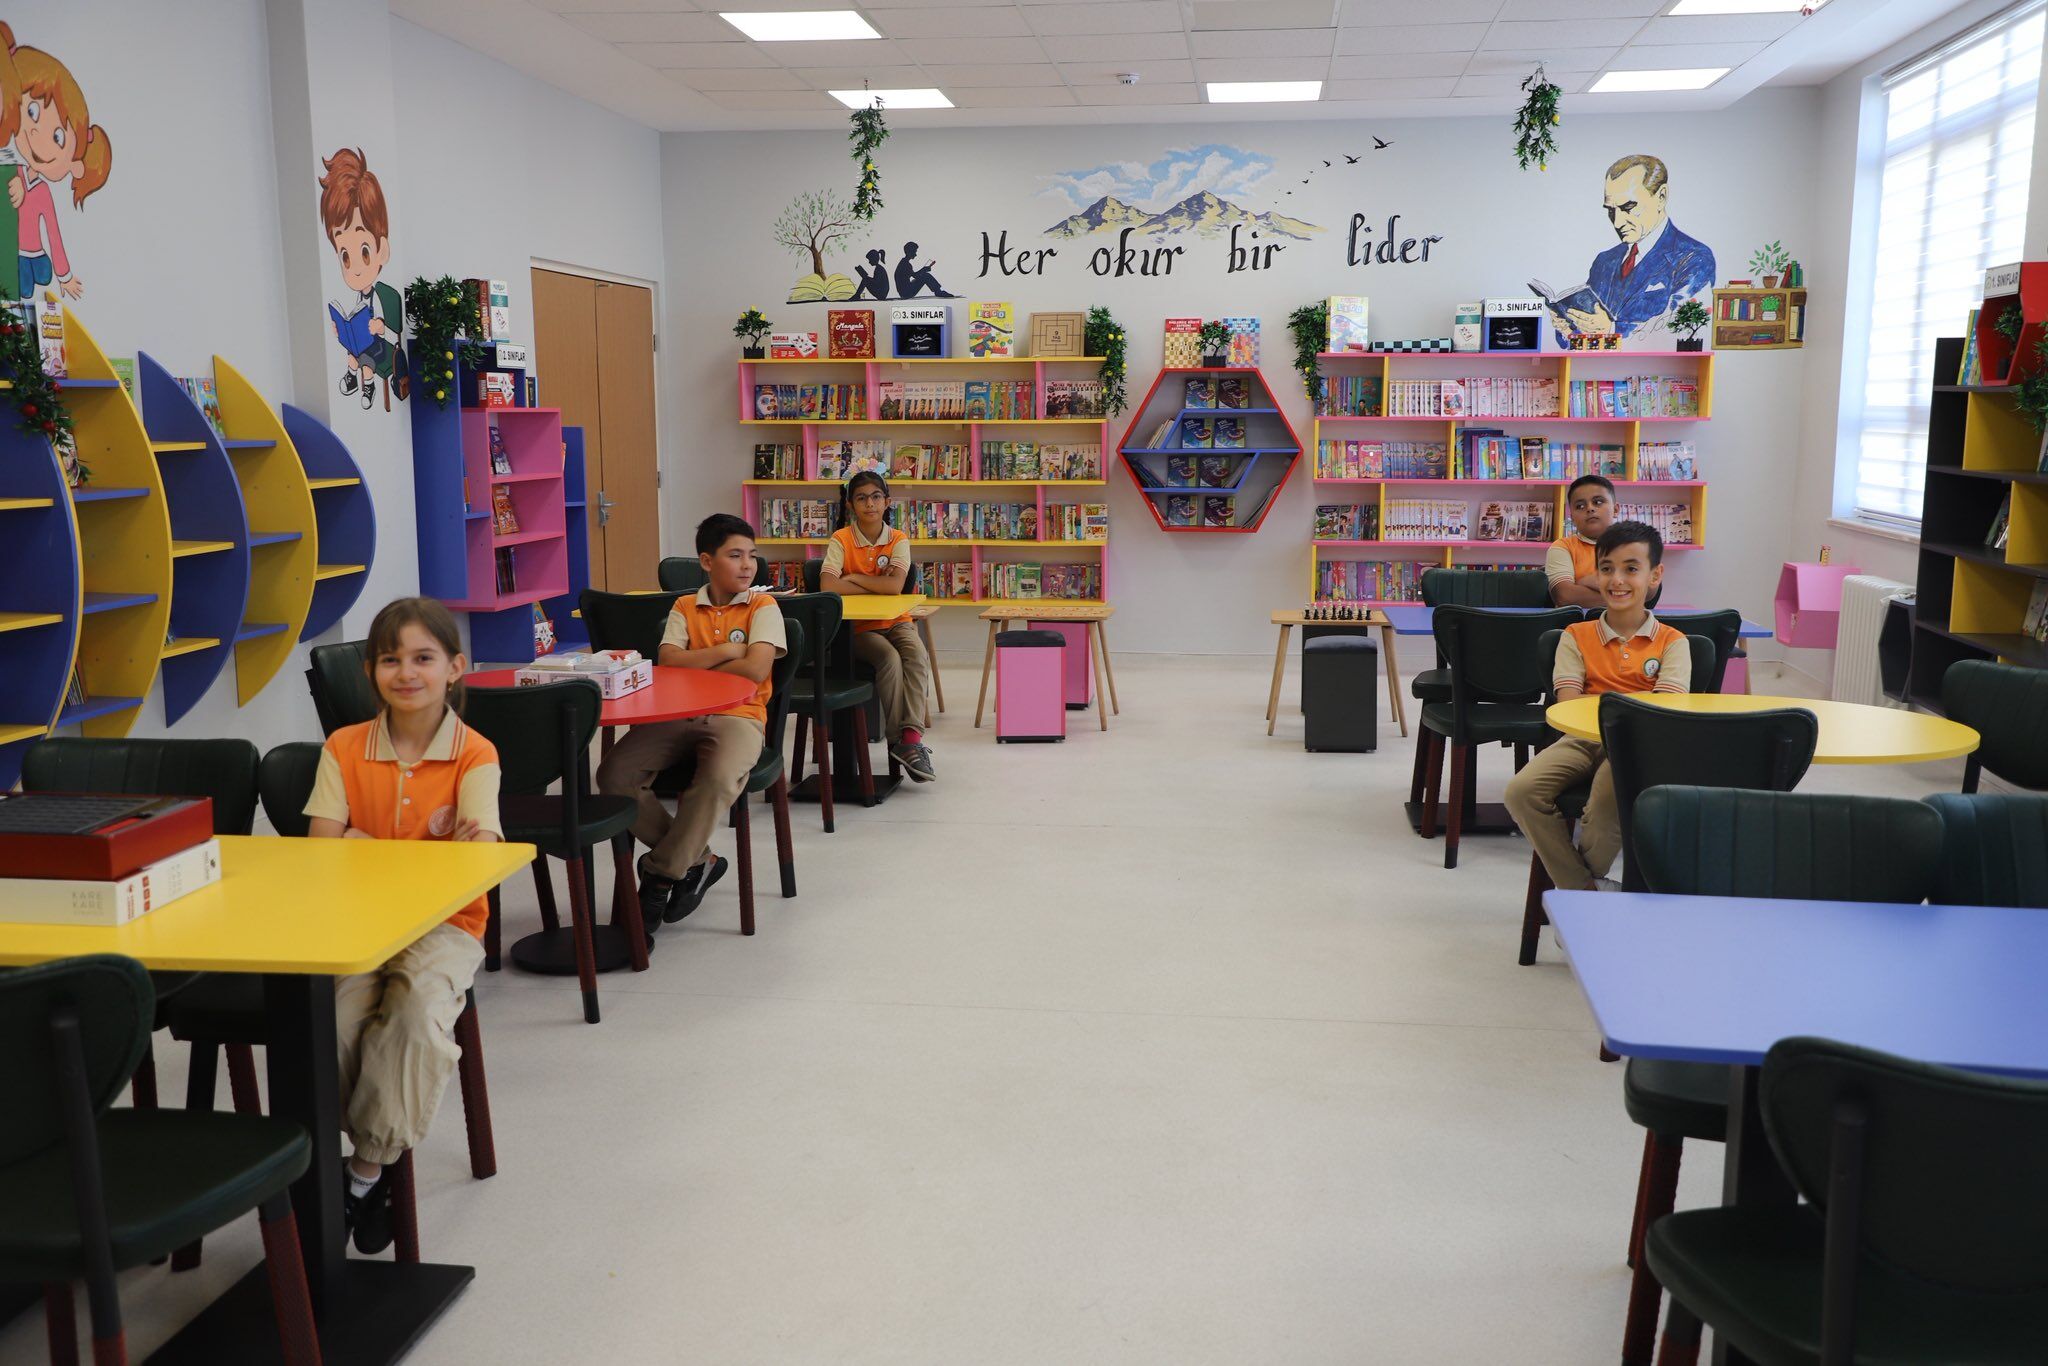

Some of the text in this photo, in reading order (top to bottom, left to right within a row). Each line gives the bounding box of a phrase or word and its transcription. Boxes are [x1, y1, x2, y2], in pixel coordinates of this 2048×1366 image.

[975, 213, 1444, 280] Her okur bir lider
[1997, 272, 2018, 287] SINIFLAR
[1497, 303, 1543, 311] 3. SINIFLAR
[902, 311, 944, 319] 3. SINIFLAR
[507, 351, 526, 361] SINIFLAR
